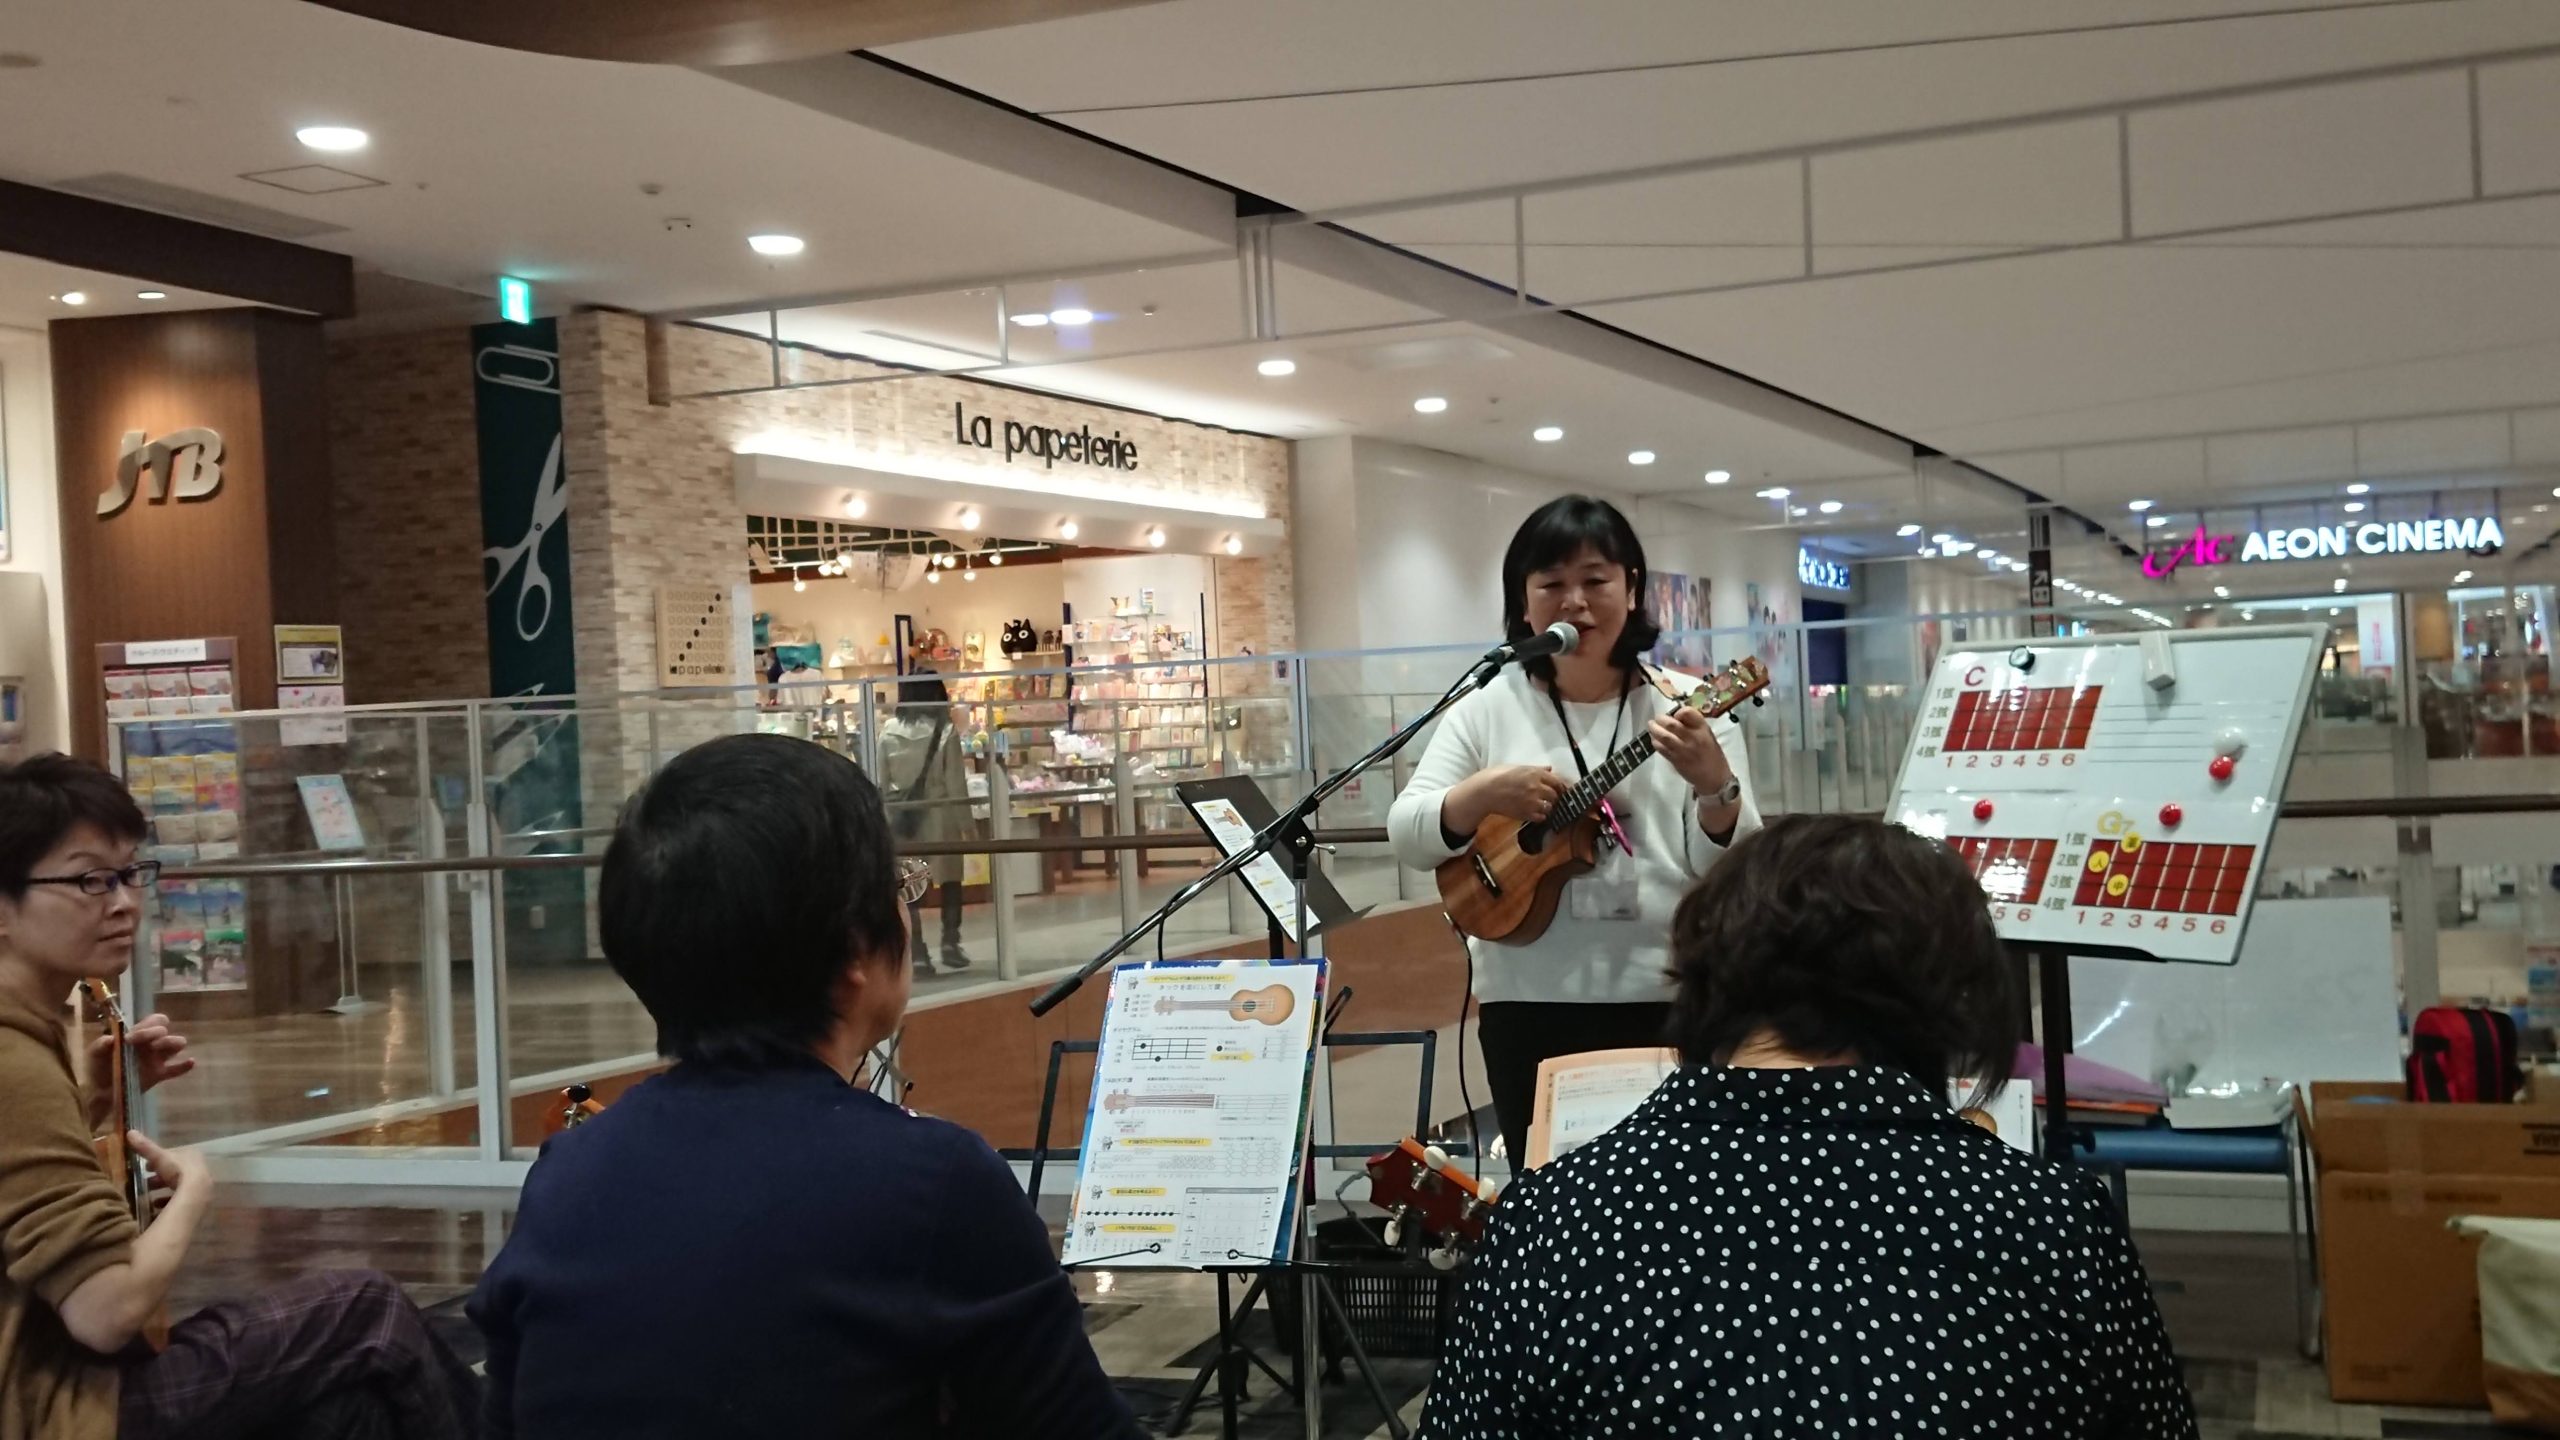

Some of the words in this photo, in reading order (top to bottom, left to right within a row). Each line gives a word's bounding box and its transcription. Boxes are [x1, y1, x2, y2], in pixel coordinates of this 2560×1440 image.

[956, 402, 992, 448] La
[1004, 421, 1138, 471] papeterie
[97, 427, 221, 514] JTB
[2241, 526, 2347, 562] AEON
[2356, 517, 2504, 554] CINEMA
[1964, 666, 1986, 687] C
[1945, 755, 1953, 768] 1
[1966, 755, 1979, 768] 2
[1990, 755, 2003, 768] 3
[2013, 754, 2026, 768] 4
[2037, 753, 2050, 767] 5
[2061, 753, 2076, 767] 6
[2017, 908, 2032, 922] 6
[2077, 910, 2085, 925] 1
[2101, 912, 2114, 927] 2
[2128, 913, 2142, 929] 3
[2154, 915, 2169, 931] 4
[2182, 917, 2197, 932] 5
[2210, 919, 2226, 934] 6
